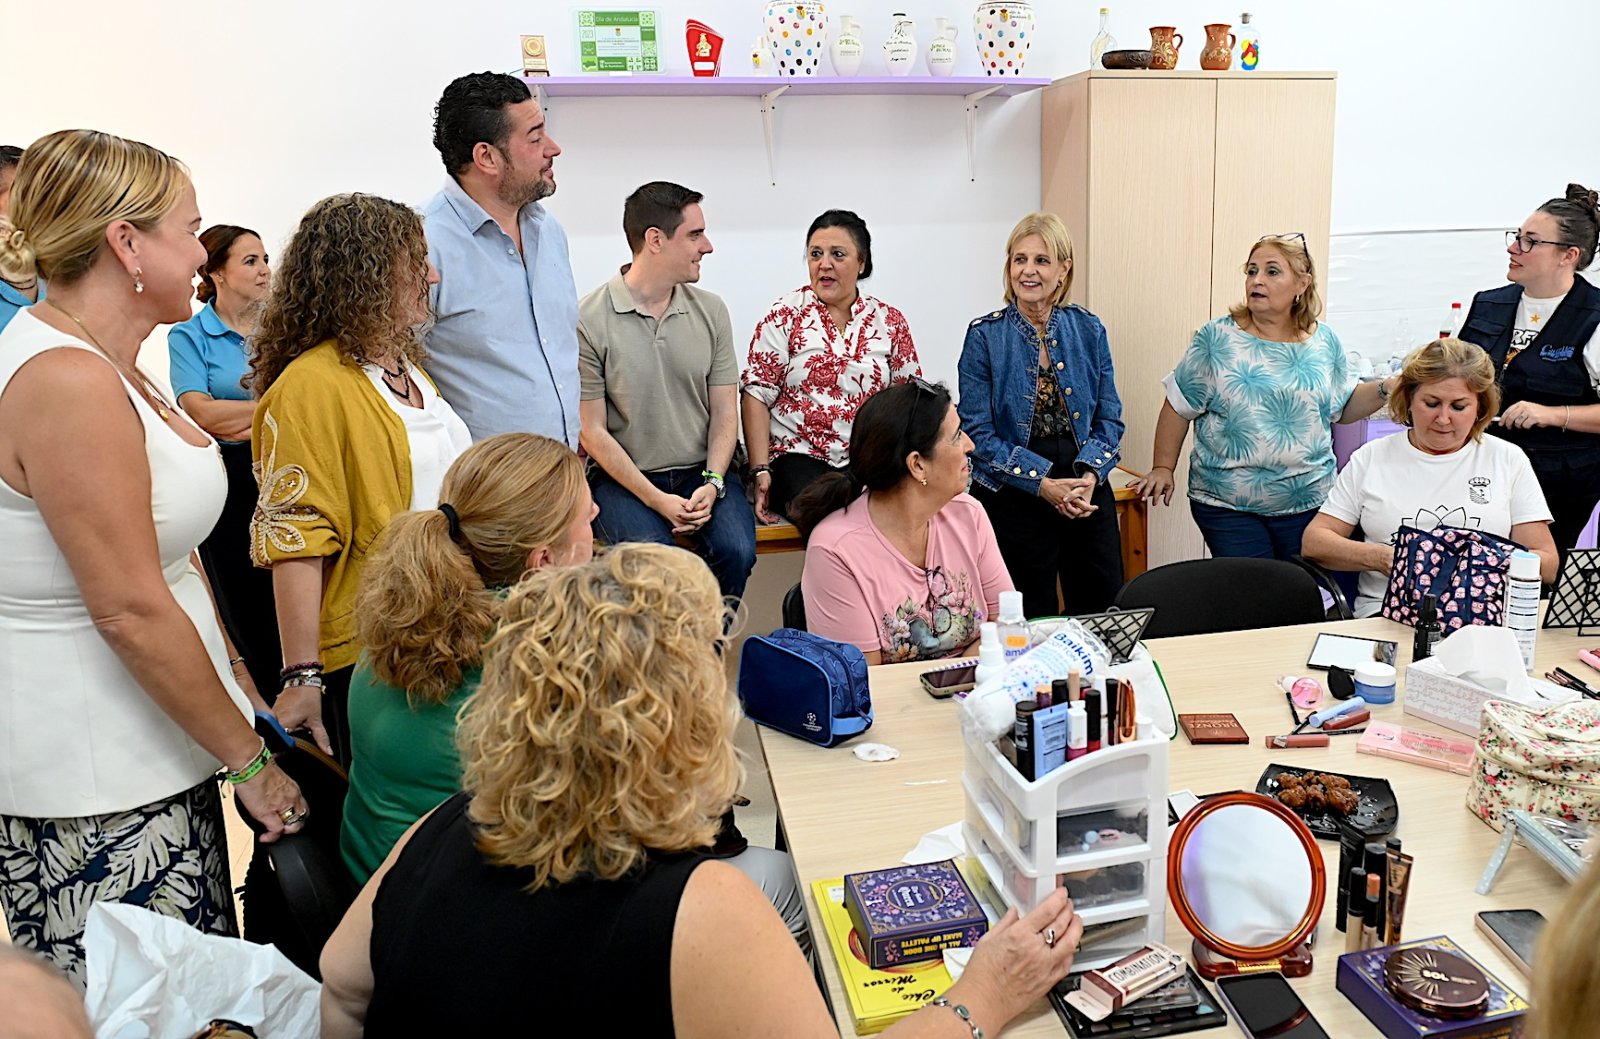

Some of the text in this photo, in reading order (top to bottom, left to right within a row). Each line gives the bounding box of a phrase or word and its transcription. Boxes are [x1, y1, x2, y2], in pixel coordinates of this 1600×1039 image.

[1053, 632, 1094, 676] Baikim
[901, 931, 963, 948] MAKE UP PALETTE
[903, 940, 961, 956] ALL IN ONE BOOK
[1107, 951, 1167, 984] COMBINATION
[863, 974, 917, 988] Mirror
[1422, 969, 1450, 983] SOL
[891, 986, 905, 994] de
[902, 989, 936, 1003] Chic
